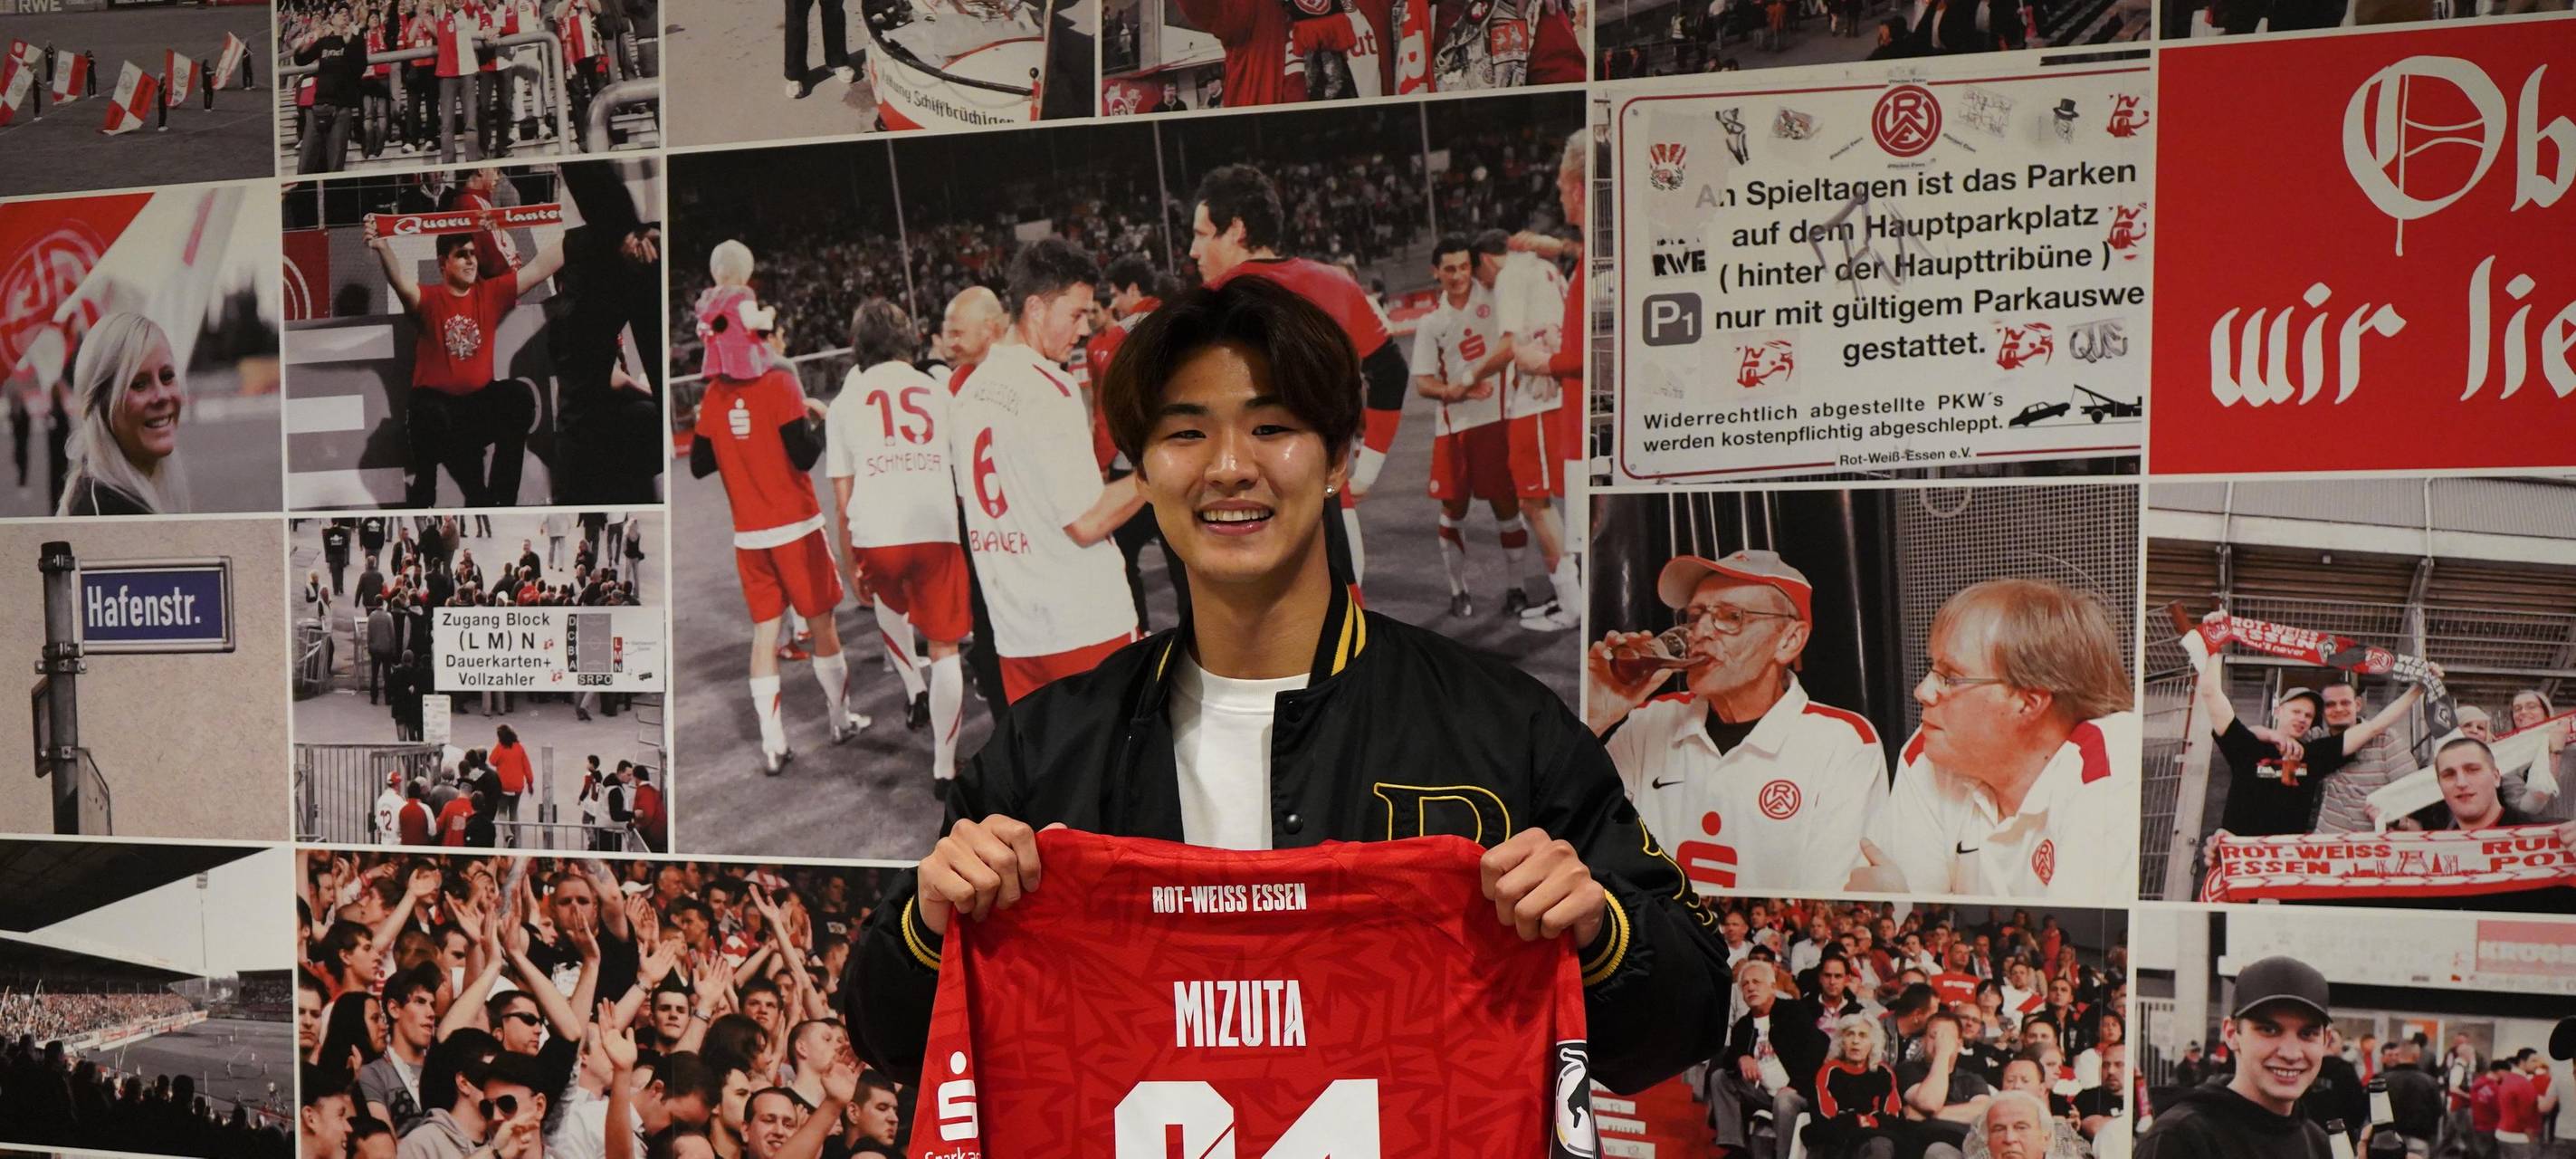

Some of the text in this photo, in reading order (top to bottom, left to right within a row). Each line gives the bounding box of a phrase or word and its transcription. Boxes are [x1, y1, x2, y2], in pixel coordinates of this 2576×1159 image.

[1746, 177, 1907, 210] Spieltagen
[1917, 170, 1953, 195] ist
[1963, 168, 2018, 192] das
[2027, 161, 2136, 188] Parken
[1732, 204, 2099, 246] auf dem Hauptparkplatz
[1652, 249, 1707, 277] RWE
[1835, 257, 1884, 280] der
[1716, 285, 2145, 330] nur mit gültigem Parkauswe
[1843, 331, 1986, 368] gestattet.
[2209, 282, 2408, 407] wir
[866, 387, 934, 445] 15
[1644, 405, 1798, 430] Widerrechtlich
[1810, 397, 1925, 420] abgestellte
[1644, 415, 2004, 452] werden kostenpflichtig abgeschleppt.
[1839, 446, 1972, 466] Rot-Weiß-Essen e.V.
[87, 584, 201, 627] Hafenstr.
[442, 612, 550, 629] Zugang Block
[521, 632, 535, 649] N
[445, 654, 552, 668] Dauerkarten+
[459, 672, 536, 686] Vollzahler
[2224, 860, 2331, 877] ESSEN
[1151, 883, 1307, 914] ROT-WEISS ESSEN
[1173, 979, 1307, 1048] MIZUTA
